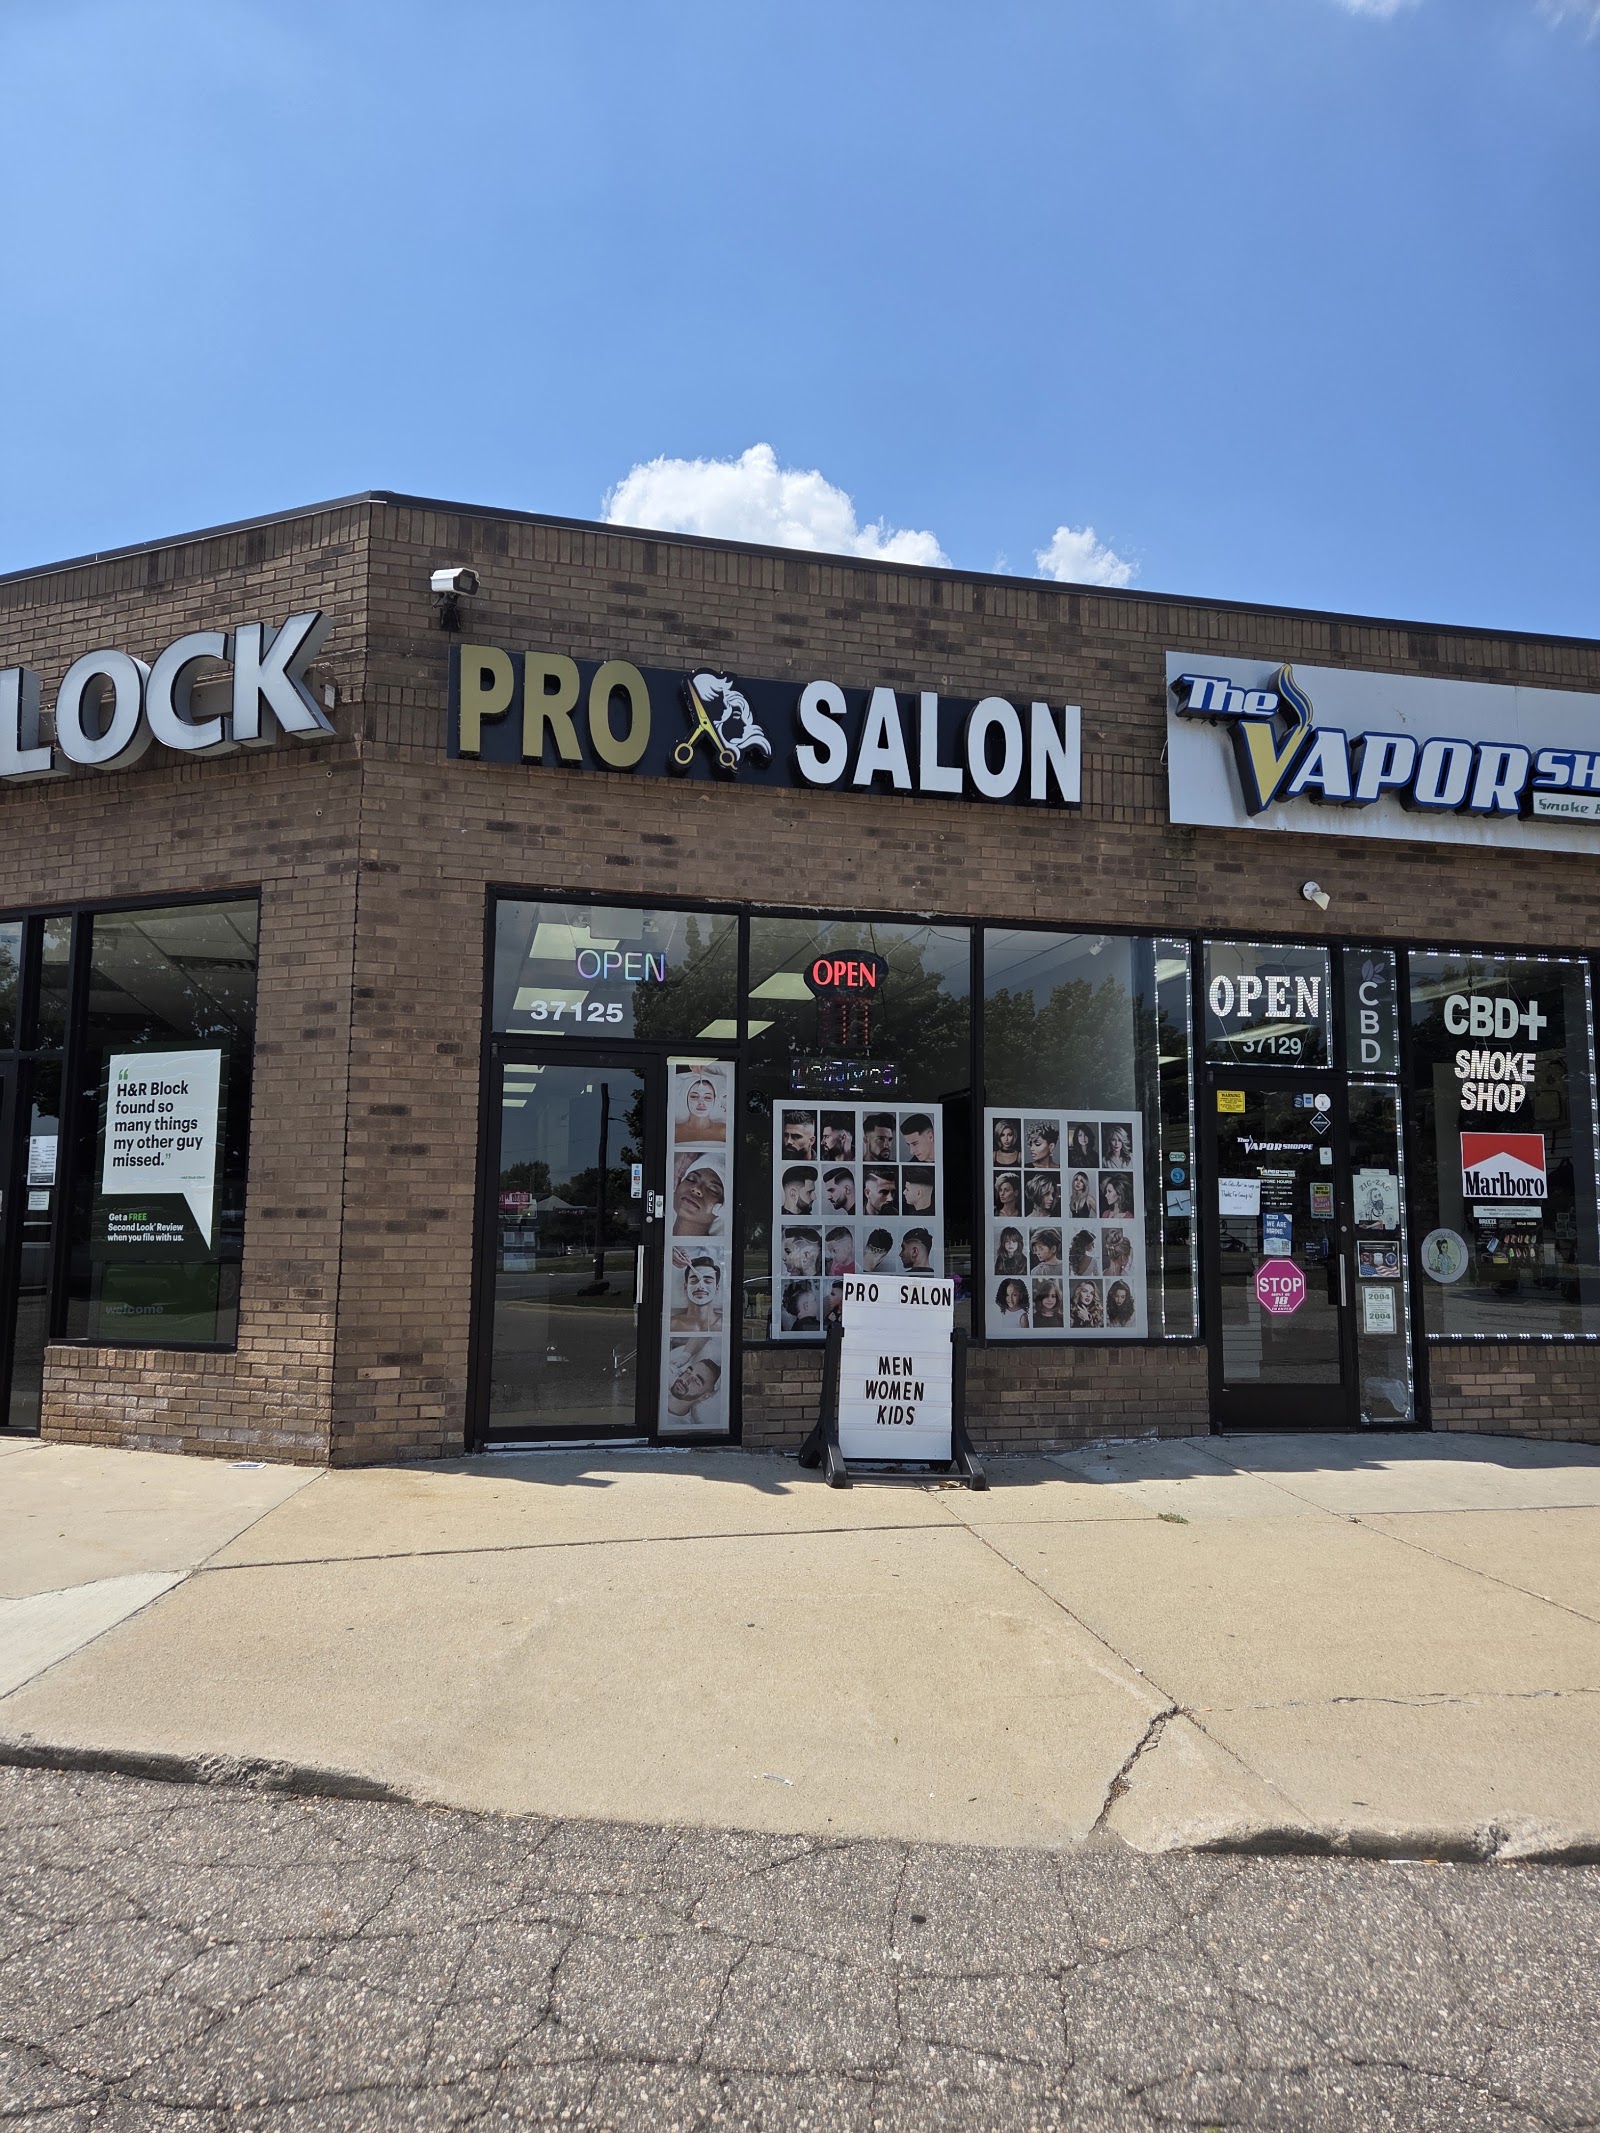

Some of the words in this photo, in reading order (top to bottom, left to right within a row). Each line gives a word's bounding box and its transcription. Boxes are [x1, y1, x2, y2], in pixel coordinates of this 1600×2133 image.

[1182, 674, 1281, 718] The
[459, 643, 651, 768] PRO
[795, 679, 1082, 803] SALON
[1234, 716, 1532, 814] VAPOR
[1539, 798, 1589, 813] Smoke
[577, 949, 665, 982] OPEN
[813, 960, 876, 988] OPEN
[1209, 975, 1322, 1018] OPEN
[531, 1001, 623, 1023] 37125
[1359, 981, 1381, 1063] CBD
[1443, 994, 1547, 1041] CBD+
[1243, 1037, 1302, 1055] 37129
[1454, 1050, 1537, 1083] SMOKE
[117, 1082, 147, 1097] H&R
[150, 1080, 189, 1095] Block
[1460, 1082, 1526, 1113] SHOP
[116, 1099, 155, 1114] found
[158, 1102, 174, 1113] so
[114, 1120, 152, 1134] many
[154, 1116, 198, 1133] things
[113, 1138, 134, 1152] my
[137, 1134, 174, 1149] other
[176, 1136, 203, 1151] guy
[1244, 1141, 1282, 1155] VAPOR
[1358, 1179, 1392, 1192] ZIG-ZAG
[1464, 1171, 1545, 1197] Marlboro
[108, 1223, 136, 1231] Second
[156, 1223, 184, 1231] Review
[109, 1213, 122, 1221] Get
[128, 1213, 147, 1221] FREE
[1276, 1220, 1287, 1228] ARE
[107, 1233, 127, 1241] when
[128, 1234, 142, 1243] you
[143, 1232, 155, 1241] file
[155, 1232, 172, 1241] with
[172, 1234, 185, 1242] us.
[844, 1282, 879, 1303] PRO
[900, 1285, 951, 1307] SALON
[1259, 1277, 1302, 1292] STOP
[105, 1305, 164, 1314] welcome
[1369, 1312, 1391, 1320] 2004
[878, 1356, 913, 1376] MEN
[865, 1380, 925, 1401] WOMEN
[877, 1405, 916, 1425] KIDS
